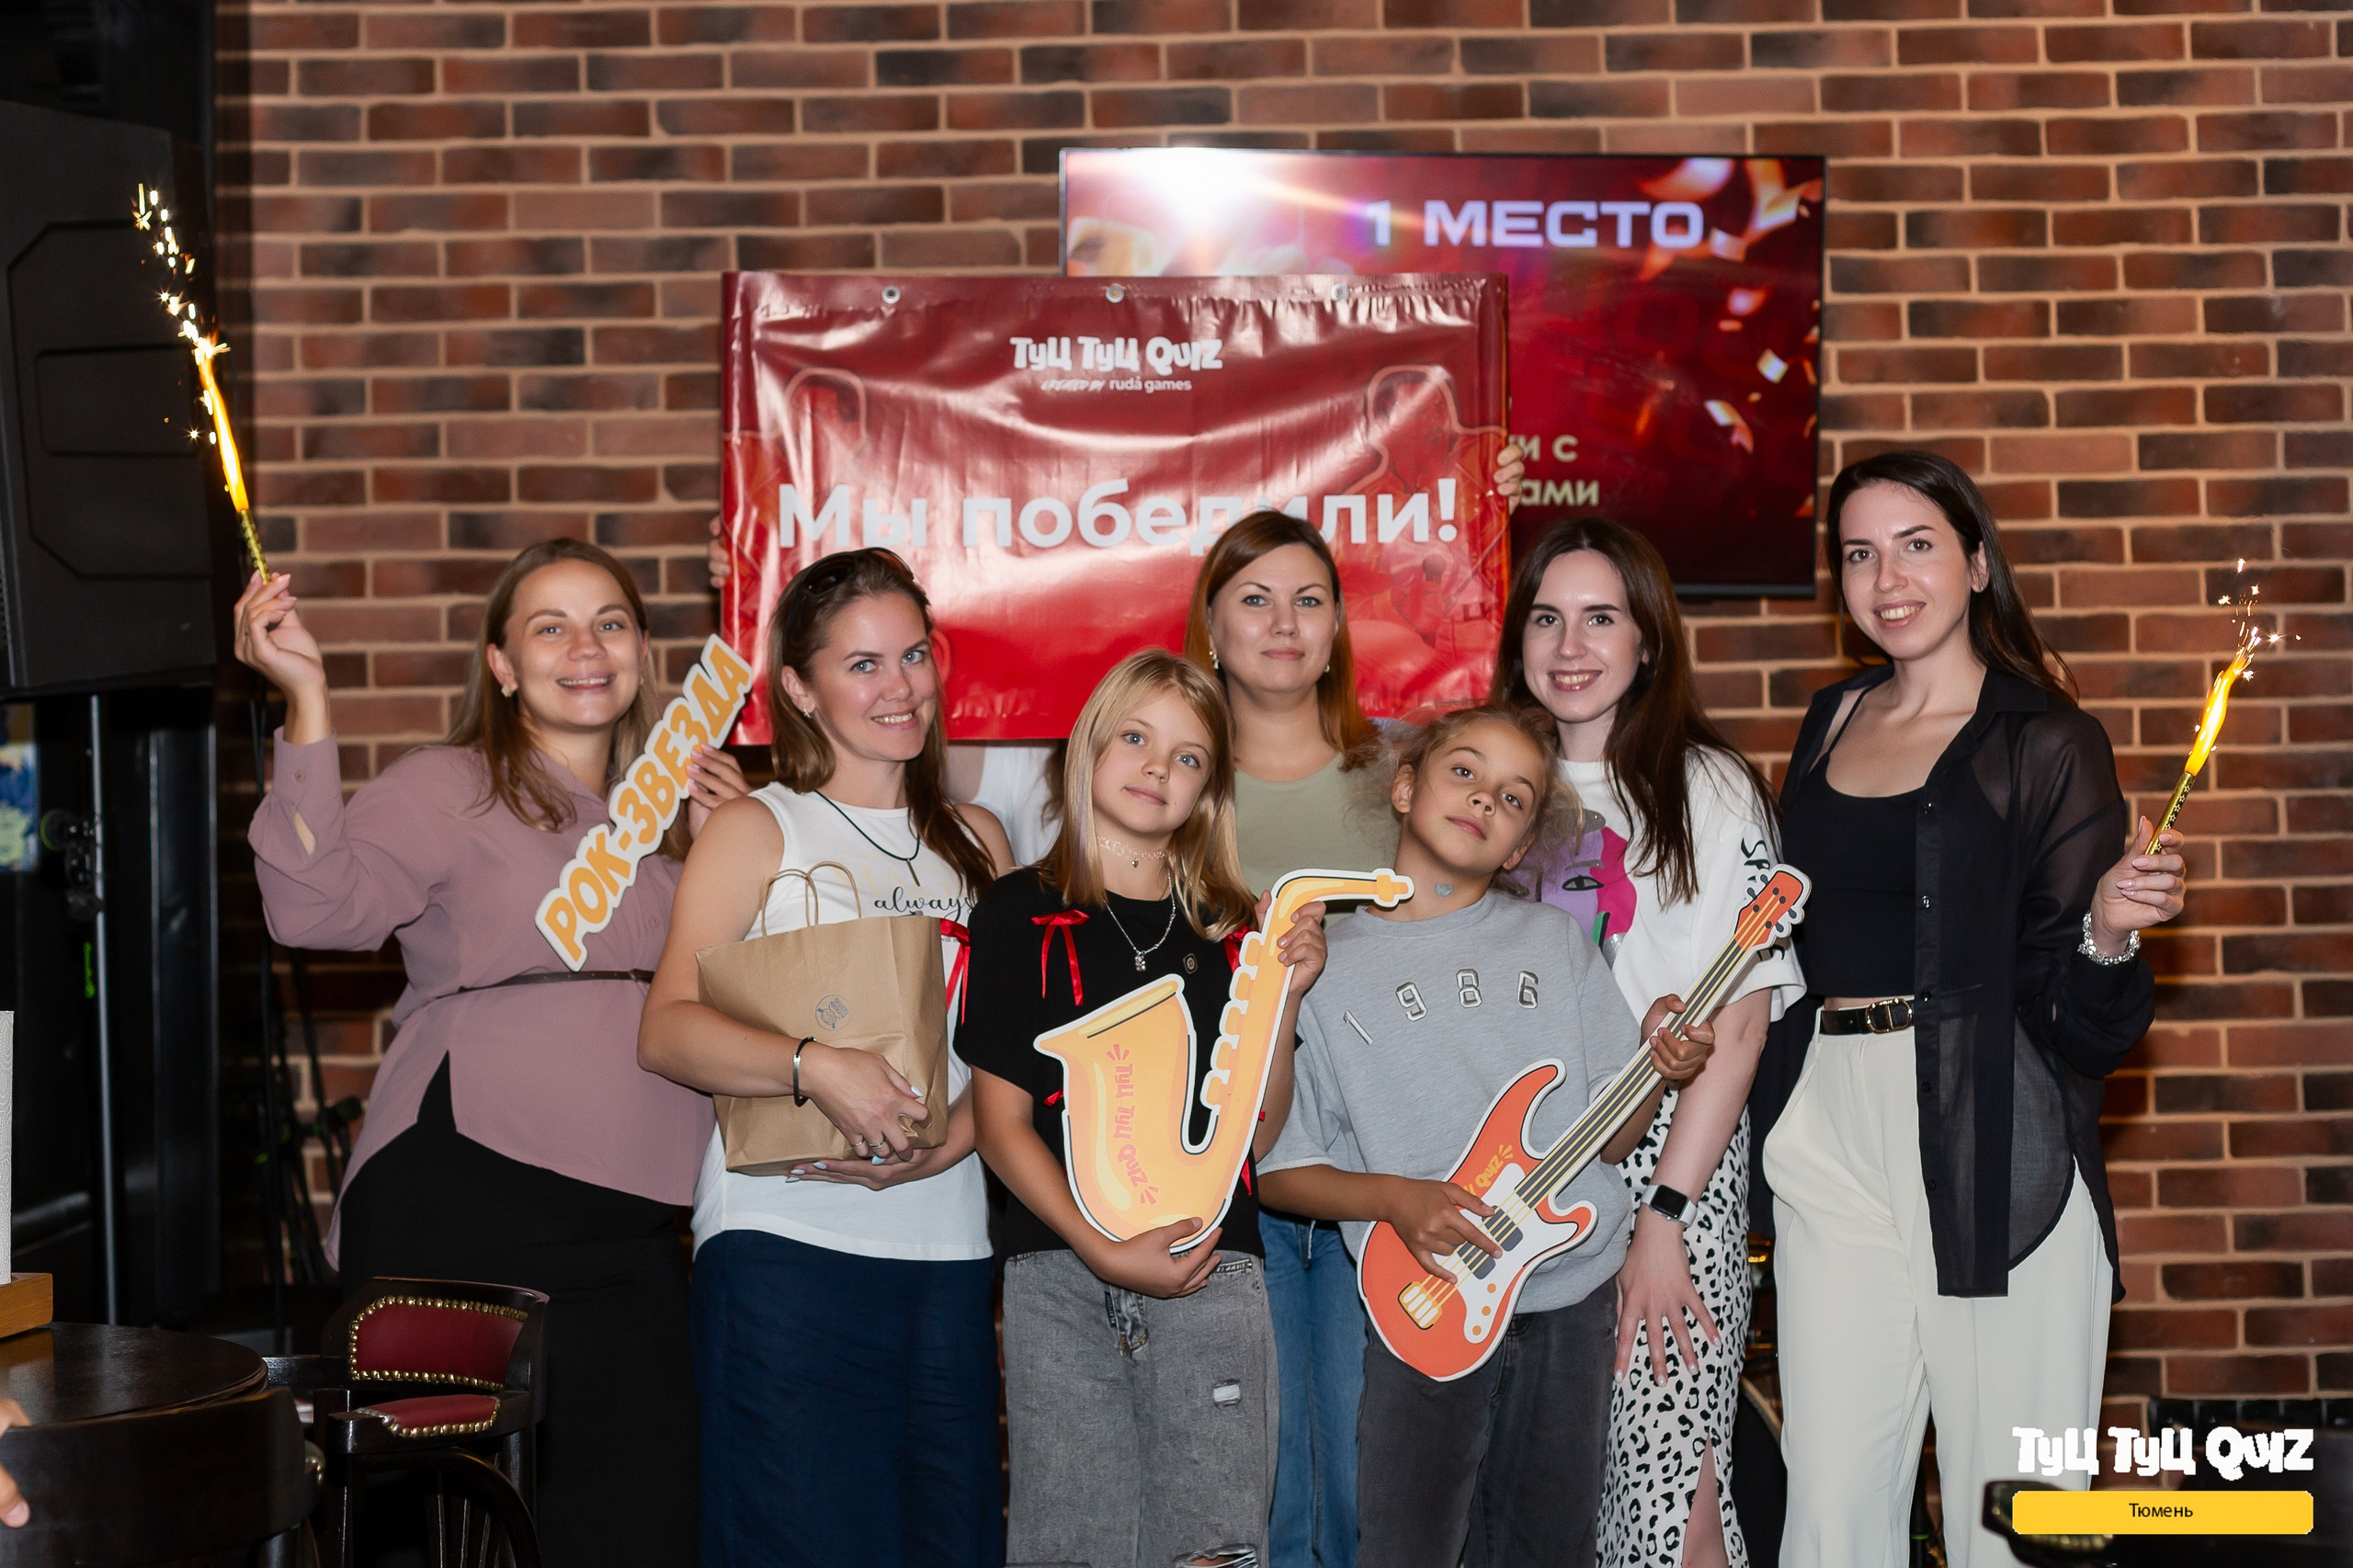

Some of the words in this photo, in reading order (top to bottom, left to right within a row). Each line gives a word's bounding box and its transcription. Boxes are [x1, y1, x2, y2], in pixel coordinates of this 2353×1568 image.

[1366, 199, 1392, 246] 1
[1423, 199, 1705, 248] МЕСТО
[1143, 379, 1192, 393] games
[778, 483, 927, 549] Мы
[1519, 478, 1600, 507] ами
[544, 642, 750, 962] РОК-ЗВЕЗДА
